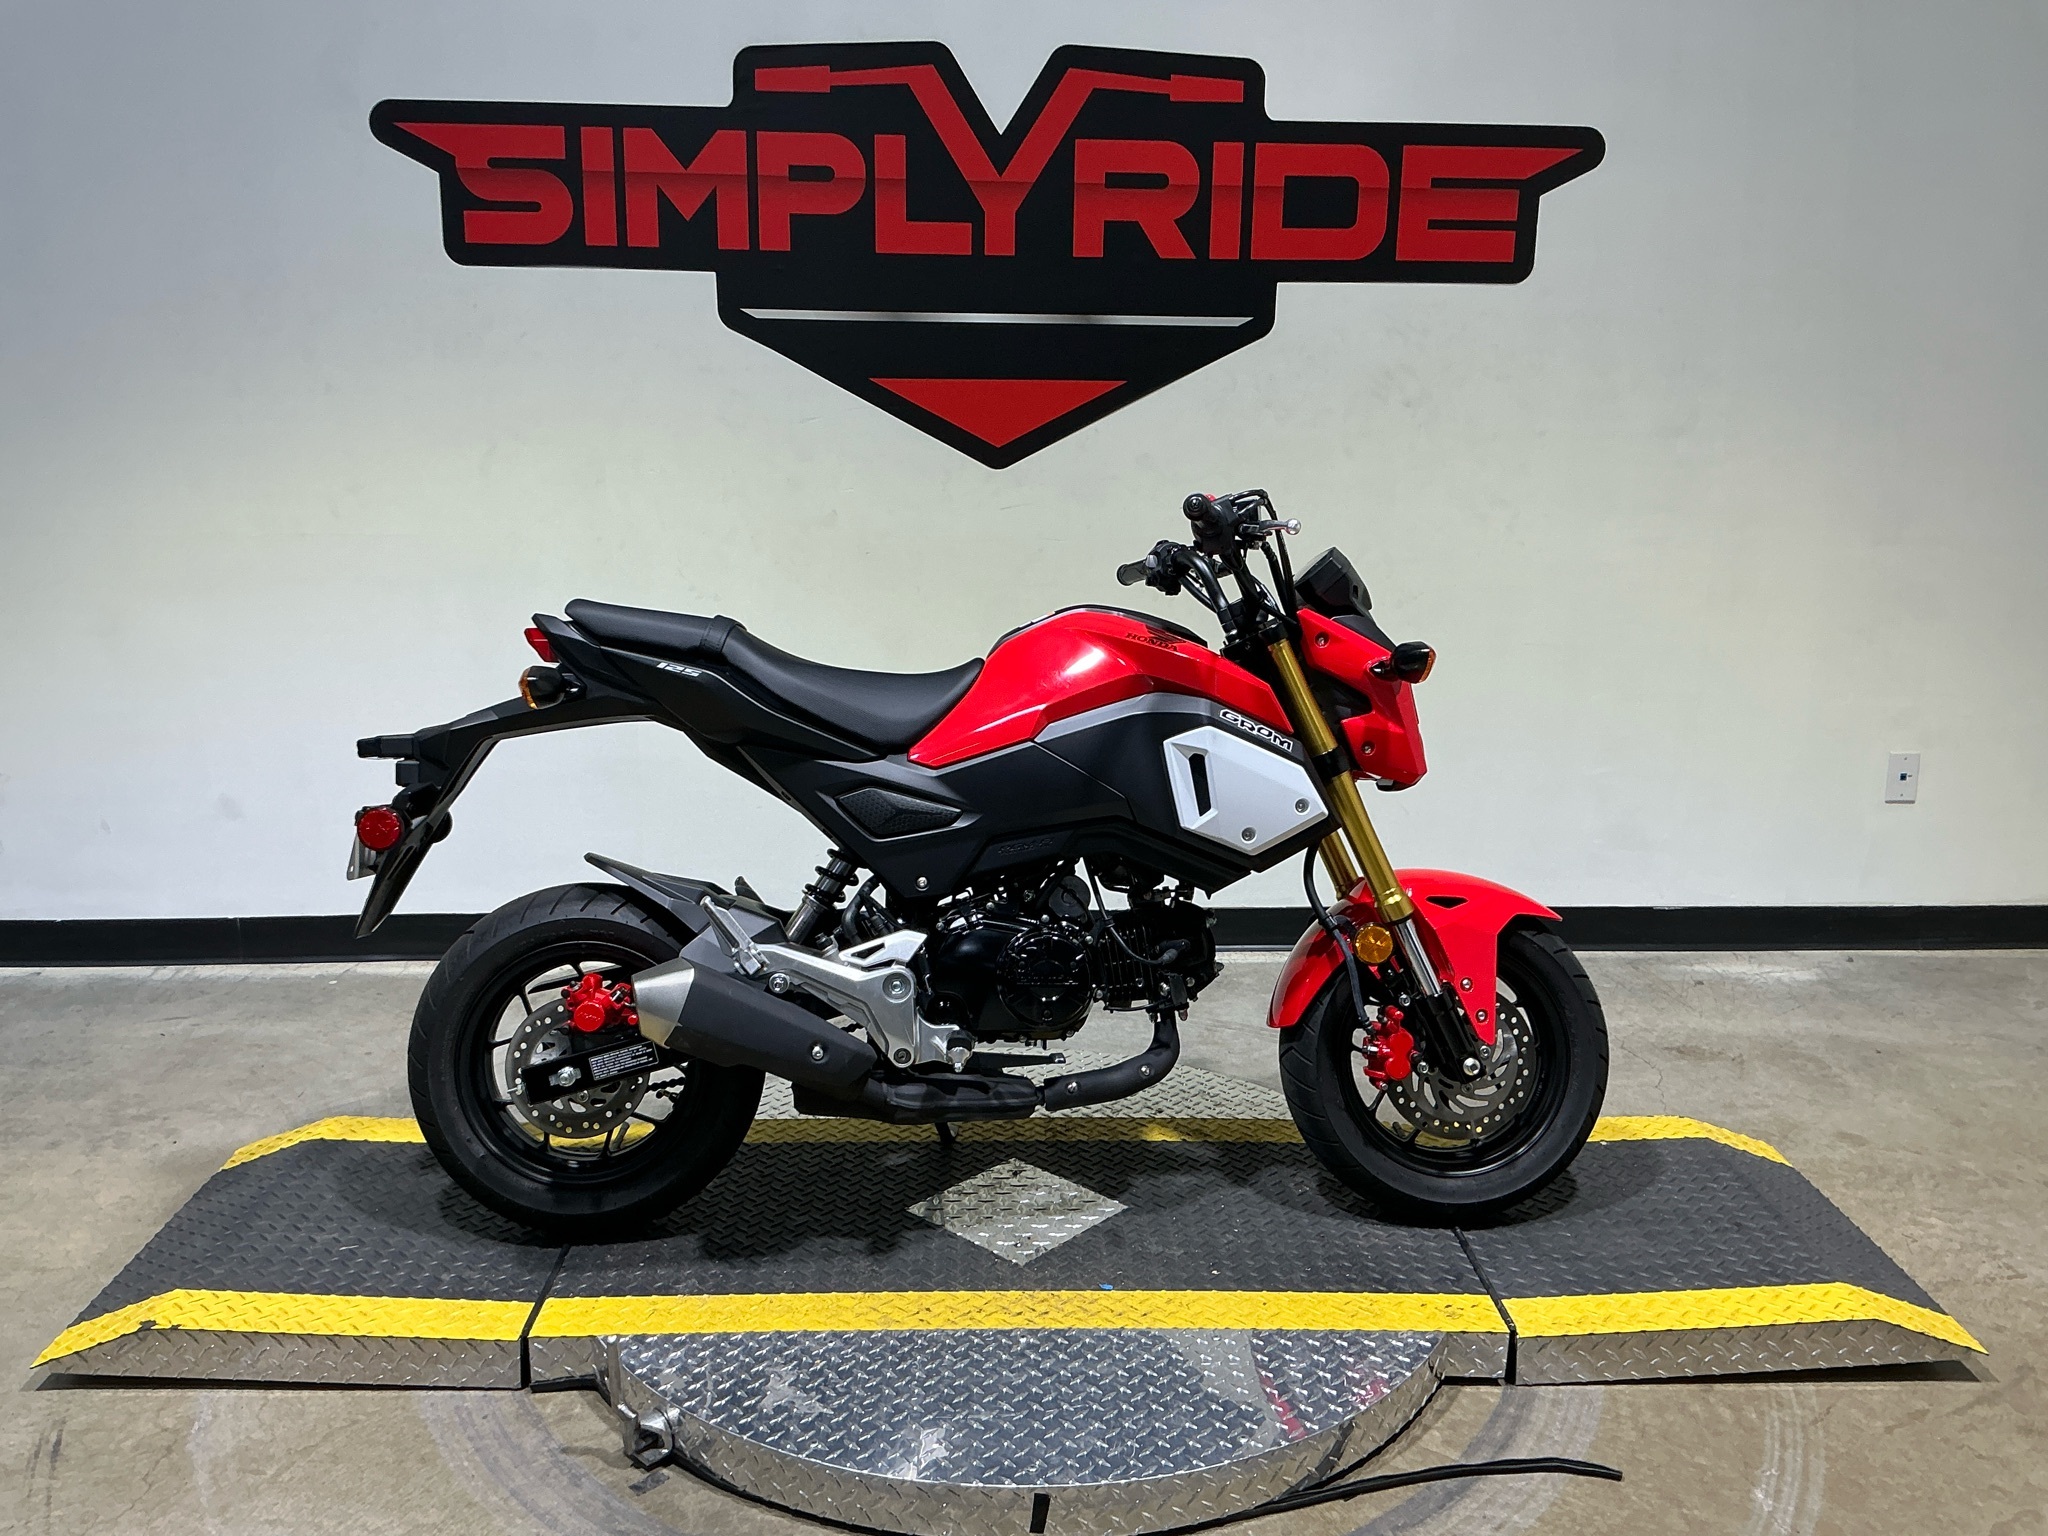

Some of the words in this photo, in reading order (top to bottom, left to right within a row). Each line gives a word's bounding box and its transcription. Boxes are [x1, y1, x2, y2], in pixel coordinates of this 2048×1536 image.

[1125, 632, 1179, 652] HONDA
[656, 662, 703, 677] 125
[1219, 708, 1294, 753] GROM
